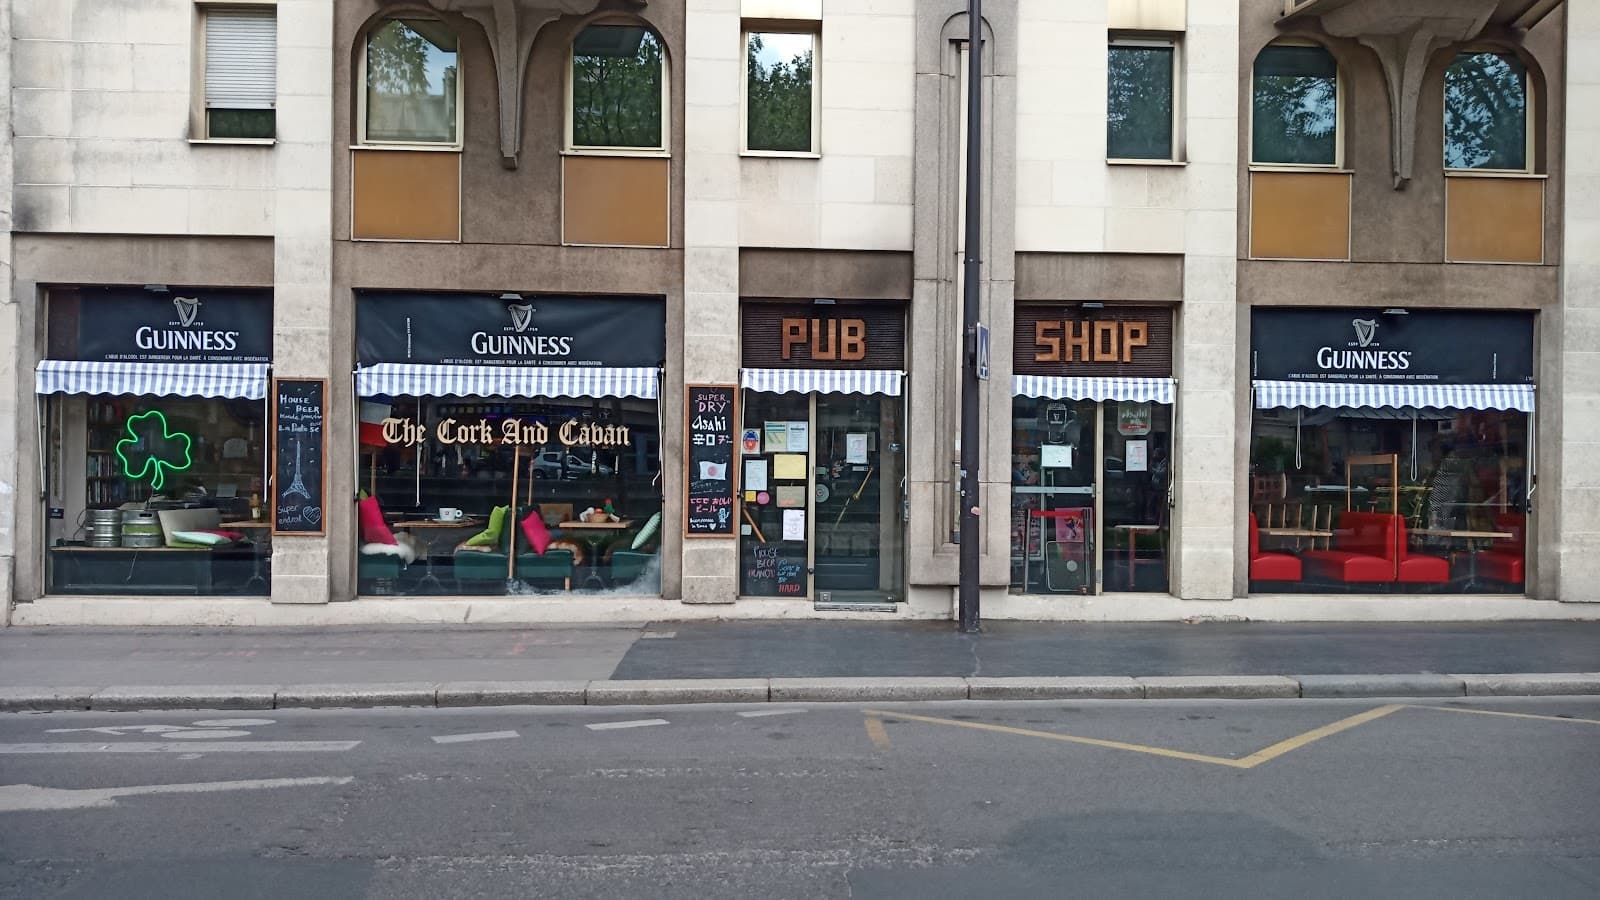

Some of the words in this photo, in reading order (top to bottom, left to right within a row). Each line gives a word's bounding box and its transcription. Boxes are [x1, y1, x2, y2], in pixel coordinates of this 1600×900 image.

[135, 326, 238, 351] GUINNESS
[471, 331, 573, 356] GUINNESS
[781, 318, 866, 361] PUB
[1035, 320, 1148, 363] SHOP
[1316, 346, 1411, 370] GUINNESS
[296, 404, 320, 414] BEER
[697, 394, 726, 402] SUPER
[699, 401, 726, 414] DRY
[382, 417, 426, 447] The
[437, 418, 493, 446] Cork
[501, 417, 548, 445] And
[558, 417, 631, 446] Cavan
[692, 414, 726, 432] Asahi
